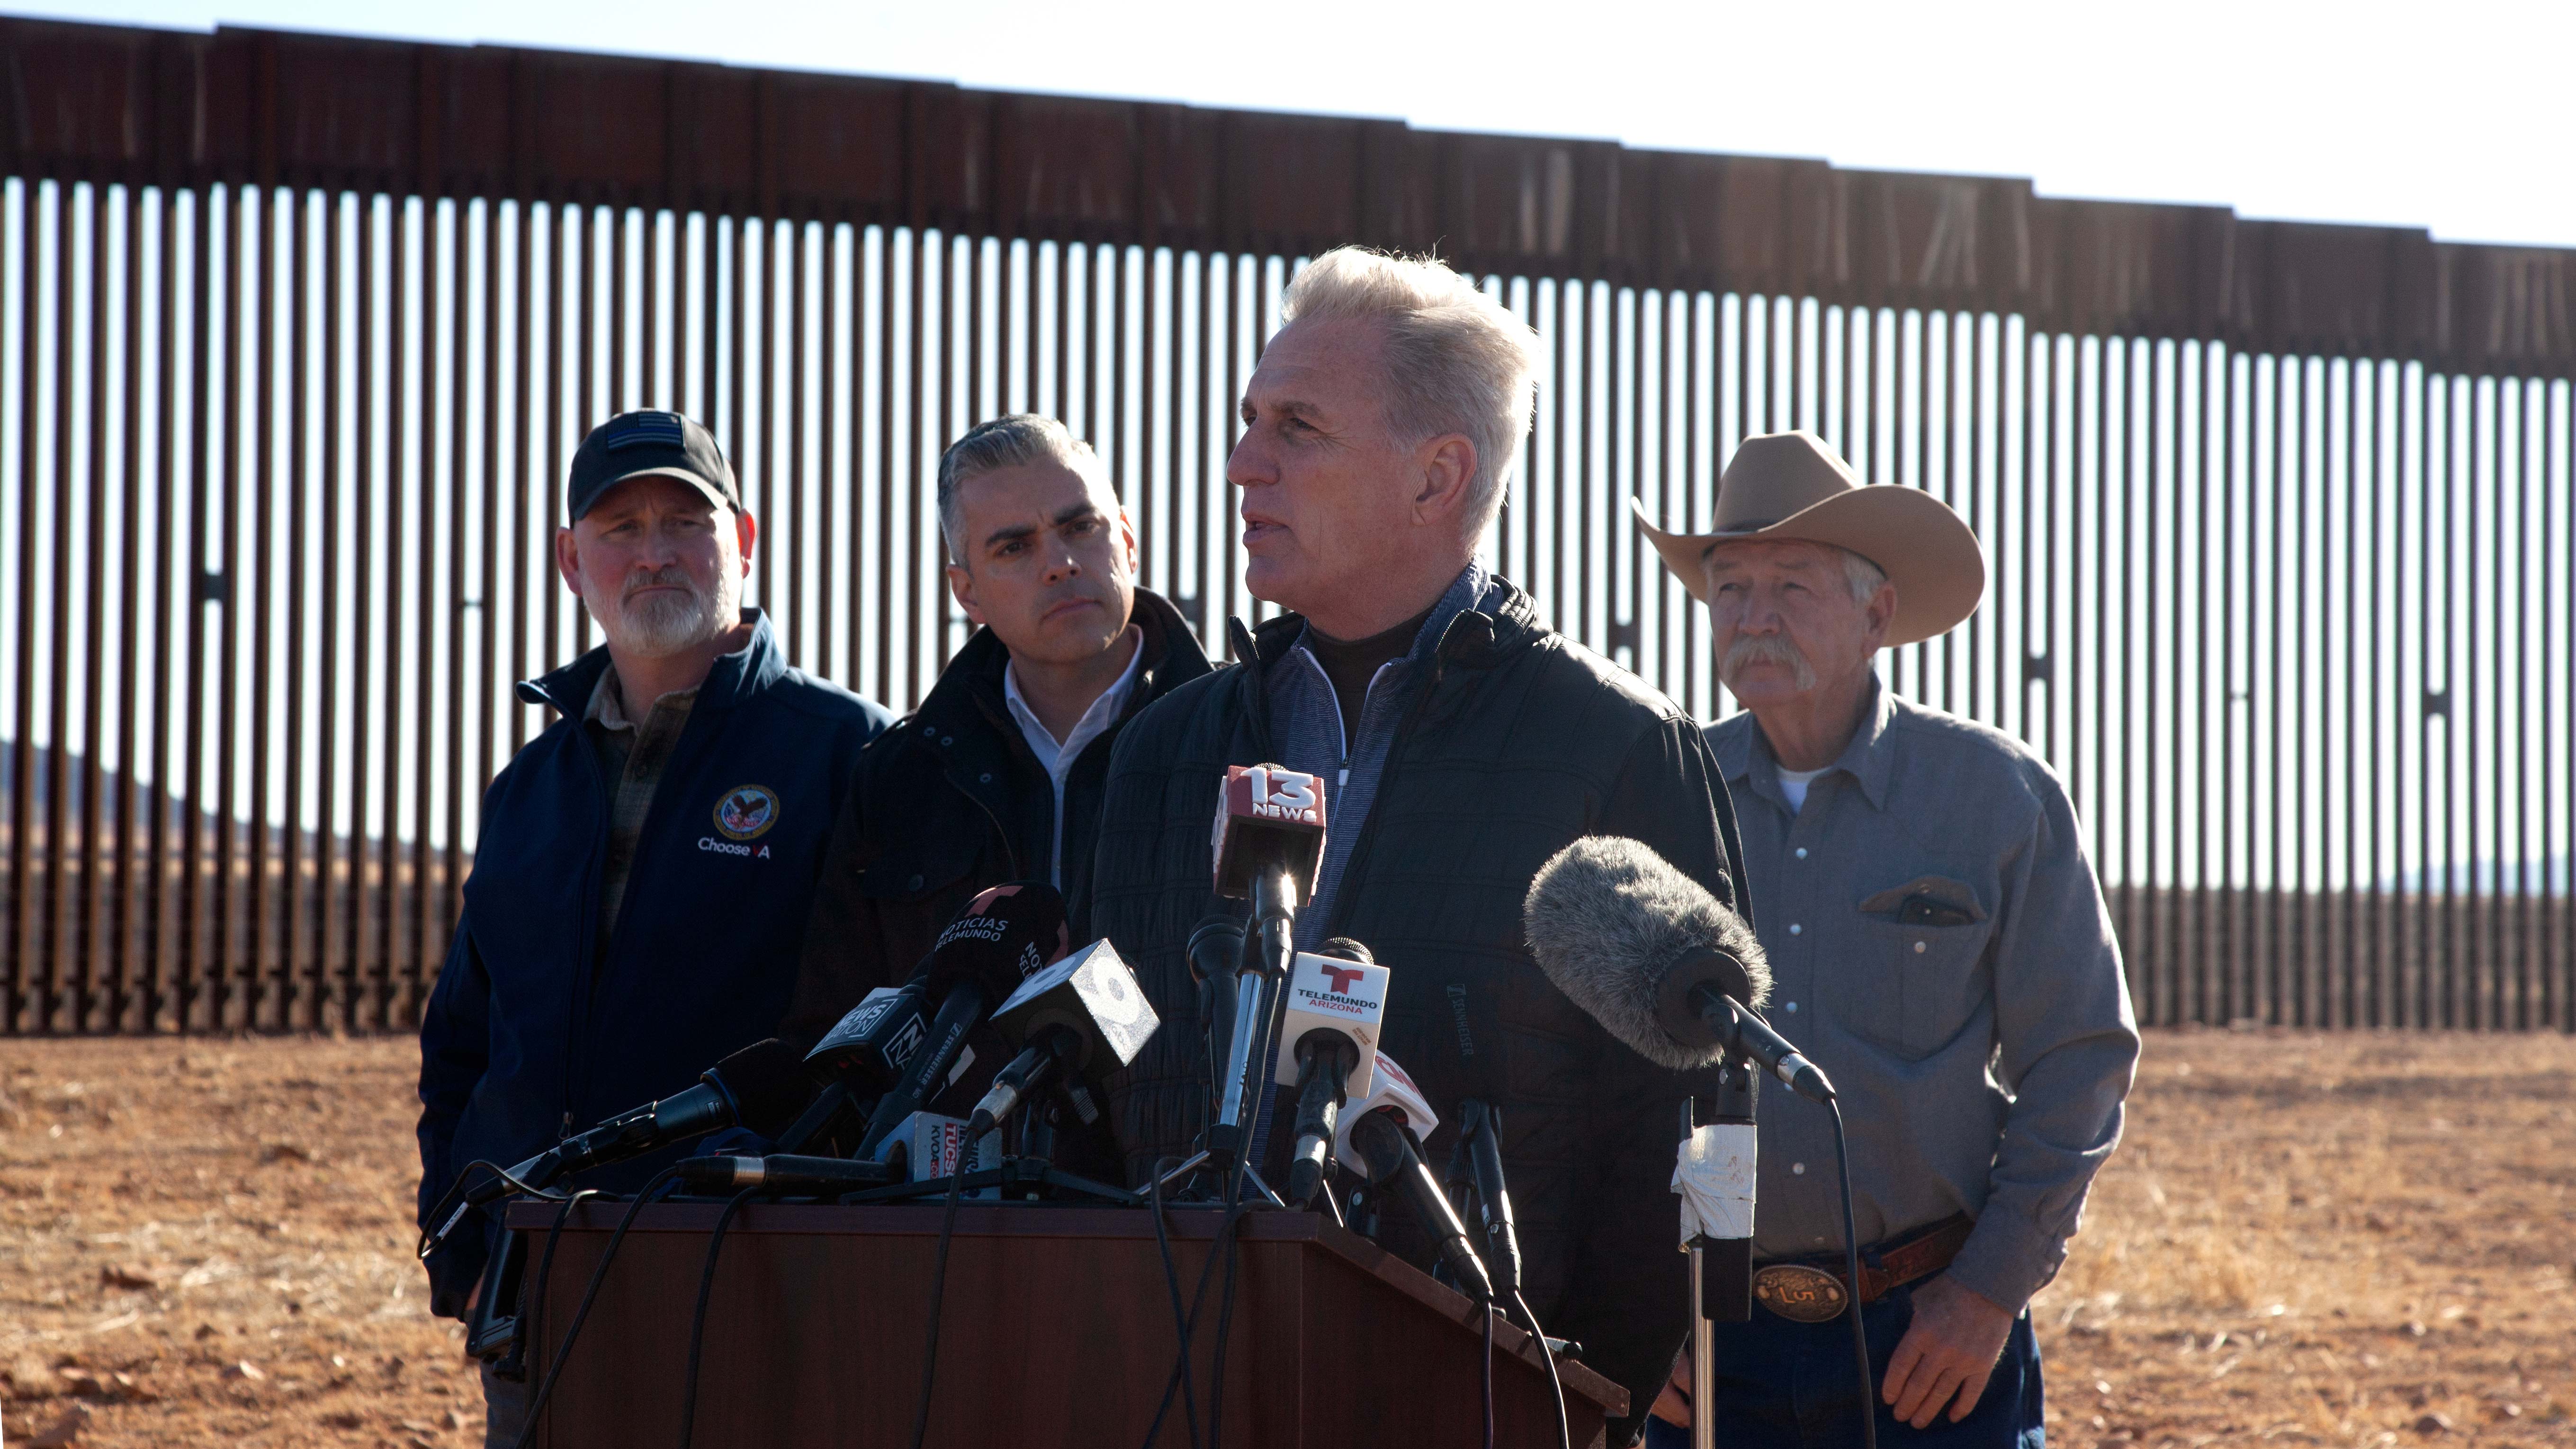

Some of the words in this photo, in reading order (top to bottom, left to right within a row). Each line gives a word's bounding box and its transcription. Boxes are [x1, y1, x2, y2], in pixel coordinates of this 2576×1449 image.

[1240, 767, 1316, 809] 13
[1252, 803, 1317, 823] NEWS
[698, 837, 750, 856] Choose
[934, 929, 1001, 952] TELEMUNDO
[937, 917, 1009, 943] NOTICIAS
[1298, 988, 1377, 1009] TELEMUNDO
[1309, 999, 1363, 1014] ARIZONA
[921, 1034, 954, 1085] SENNHEISER
